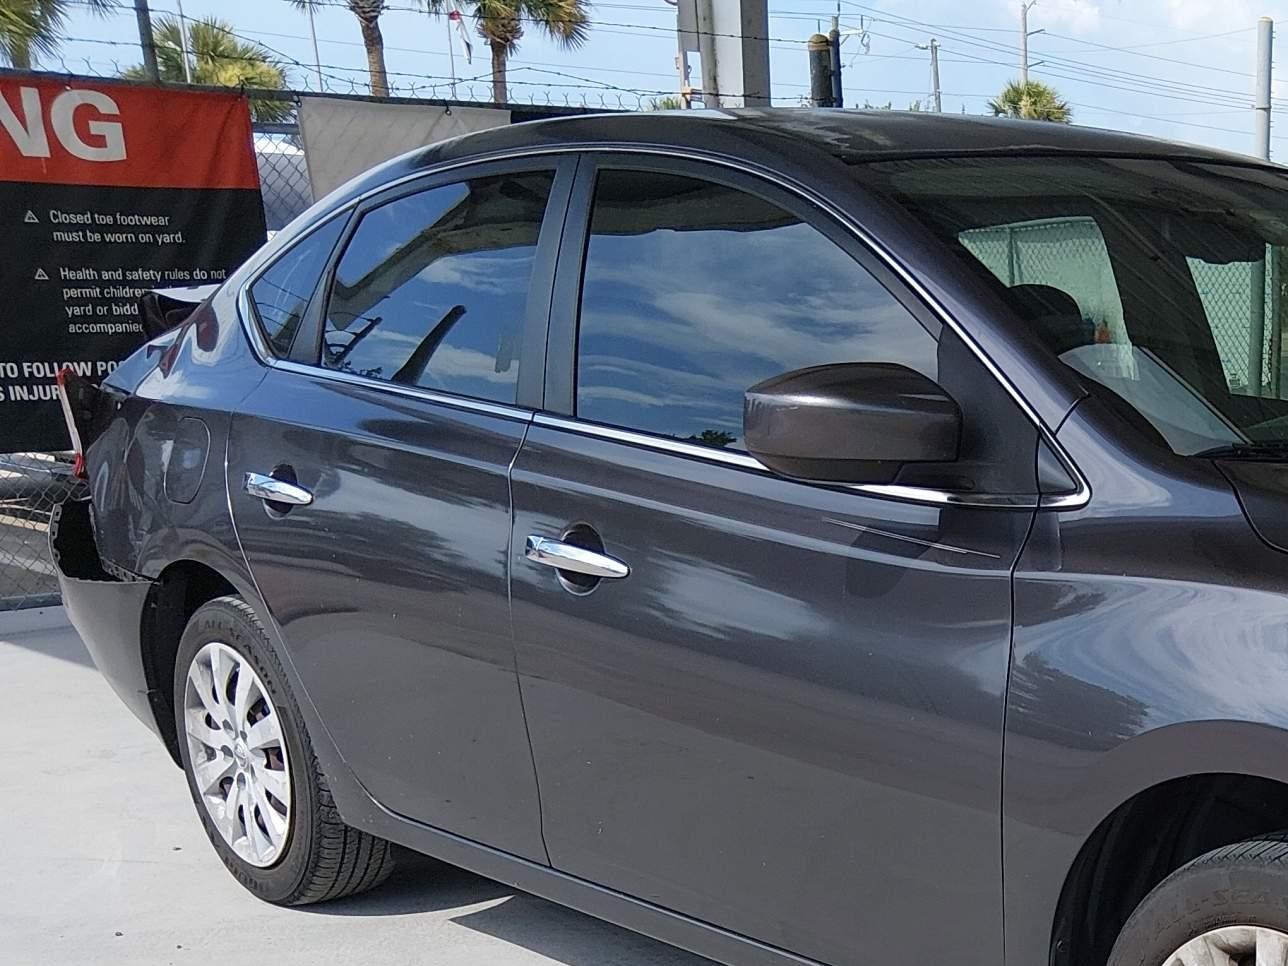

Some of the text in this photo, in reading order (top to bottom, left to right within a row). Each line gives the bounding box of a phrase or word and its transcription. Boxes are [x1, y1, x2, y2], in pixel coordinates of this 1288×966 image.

[0, 86, 127, 161] NG
[50, 210, 169, 227] Closed toe footwear
[53, 230, 186, 246] must be worn on yard.
[60, 267, 227, 282] Health and safety rules do not
[63, 285, 100, 301] permit
[65, 303, 139, 318] yard or bidd
[9, 384, 61, 401] INJUR
